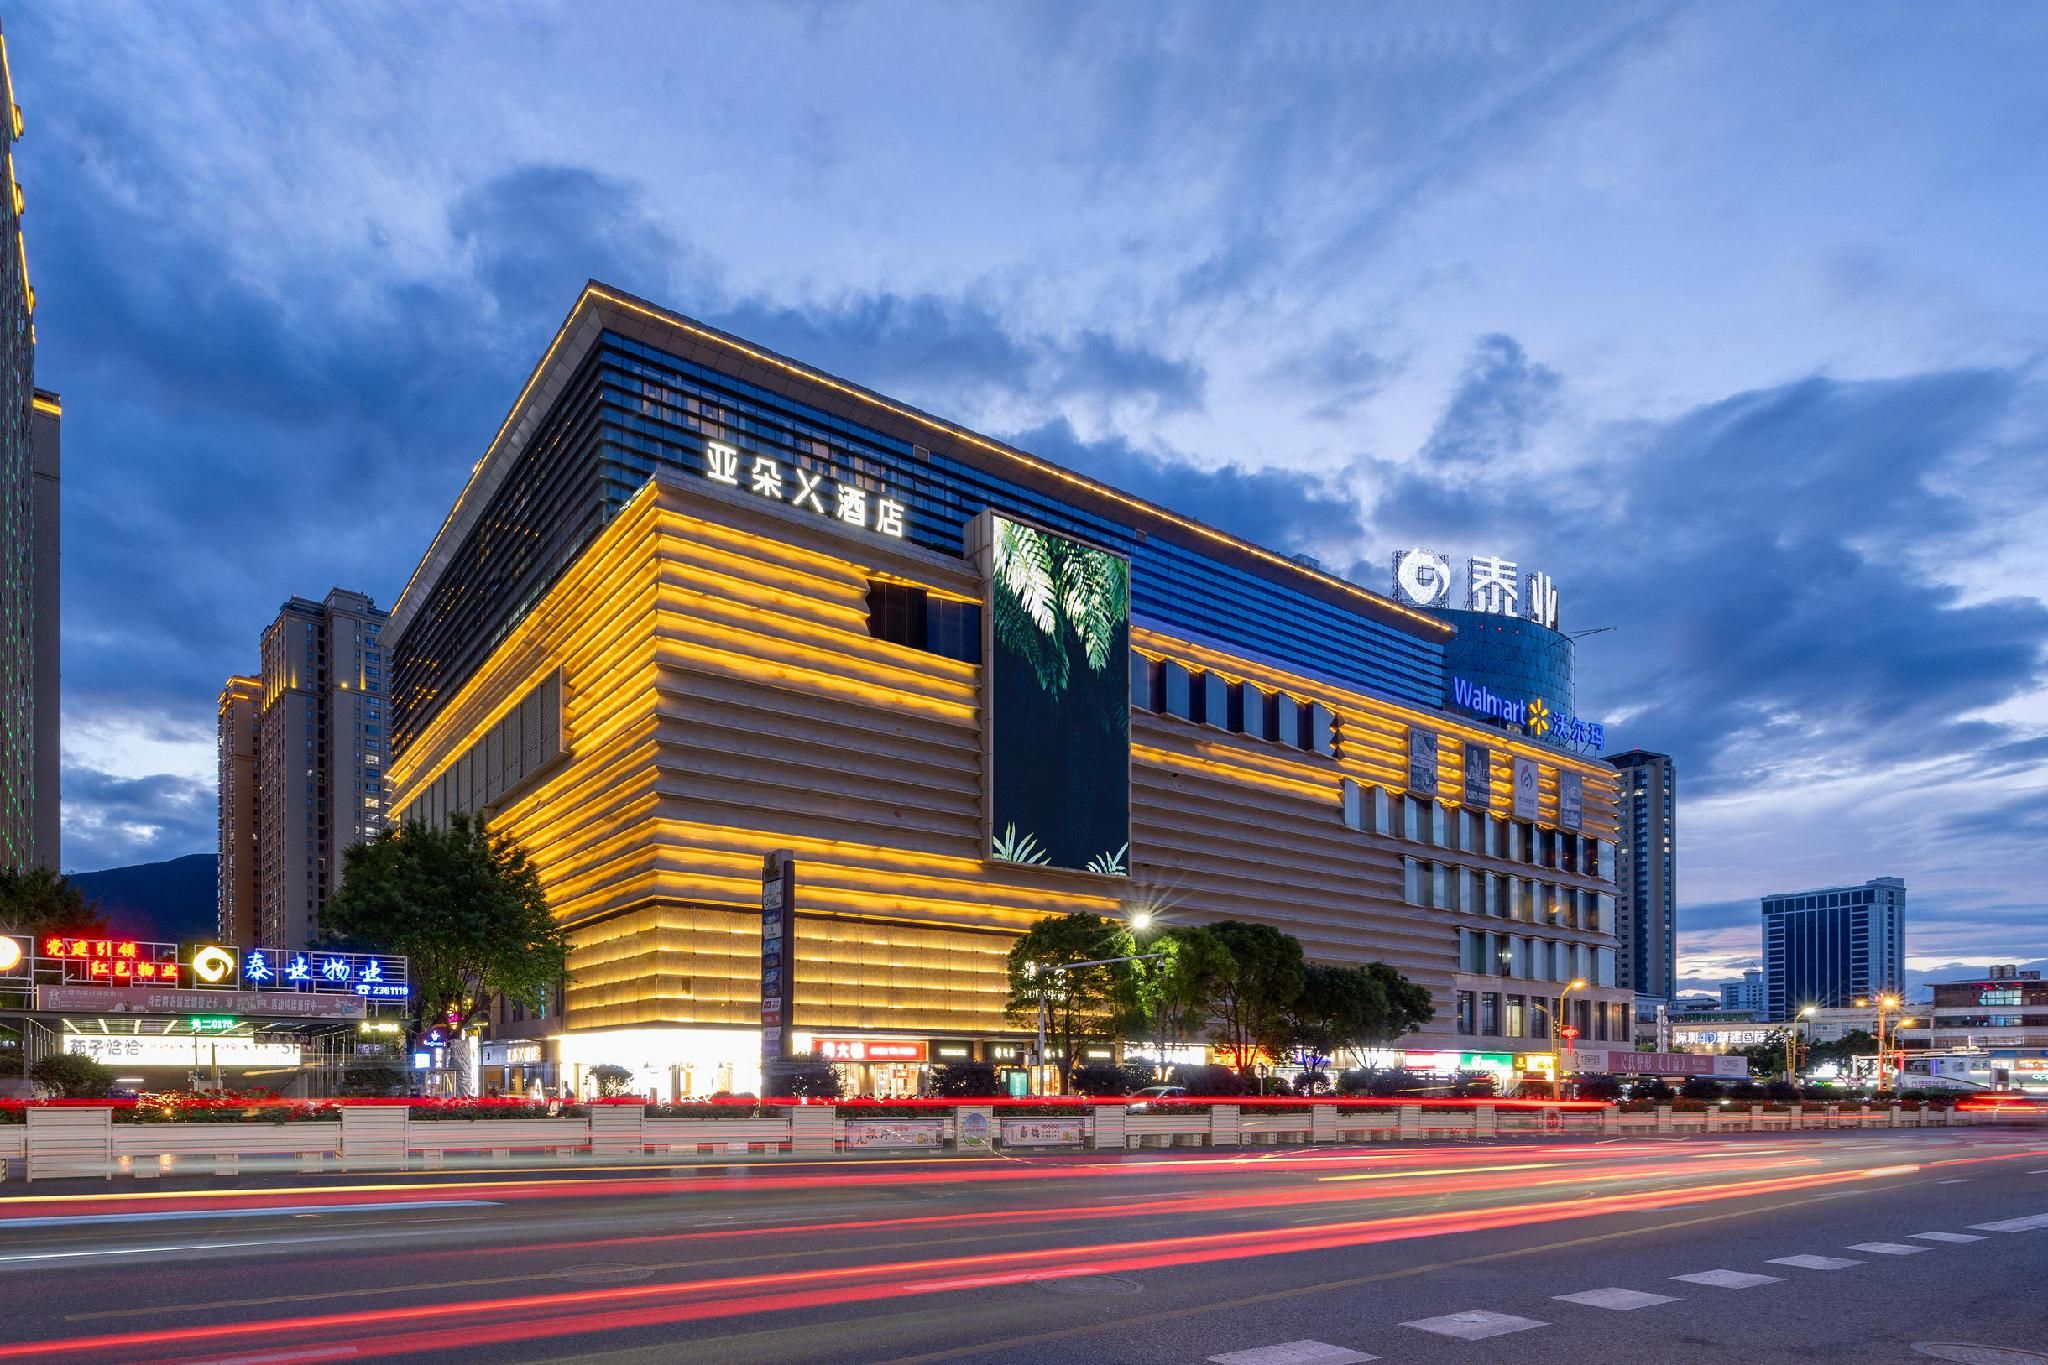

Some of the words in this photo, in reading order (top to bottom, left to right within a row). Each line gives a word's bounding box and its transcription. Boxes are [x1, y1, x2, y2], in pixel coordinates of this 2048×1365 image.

[707, 441, 904, 538] 亚朵X酒店
[1472, 555, 1558, 629] 泰业
[1453, 676, 1527, 725] Walmart
[1553, 711, 1605, 750] 沃尔玛
[47, 938, 136, 958] 党建引领
[245, 951, 385, 982] 泰业物业
[91, 960, 178, 978] 红色物业
